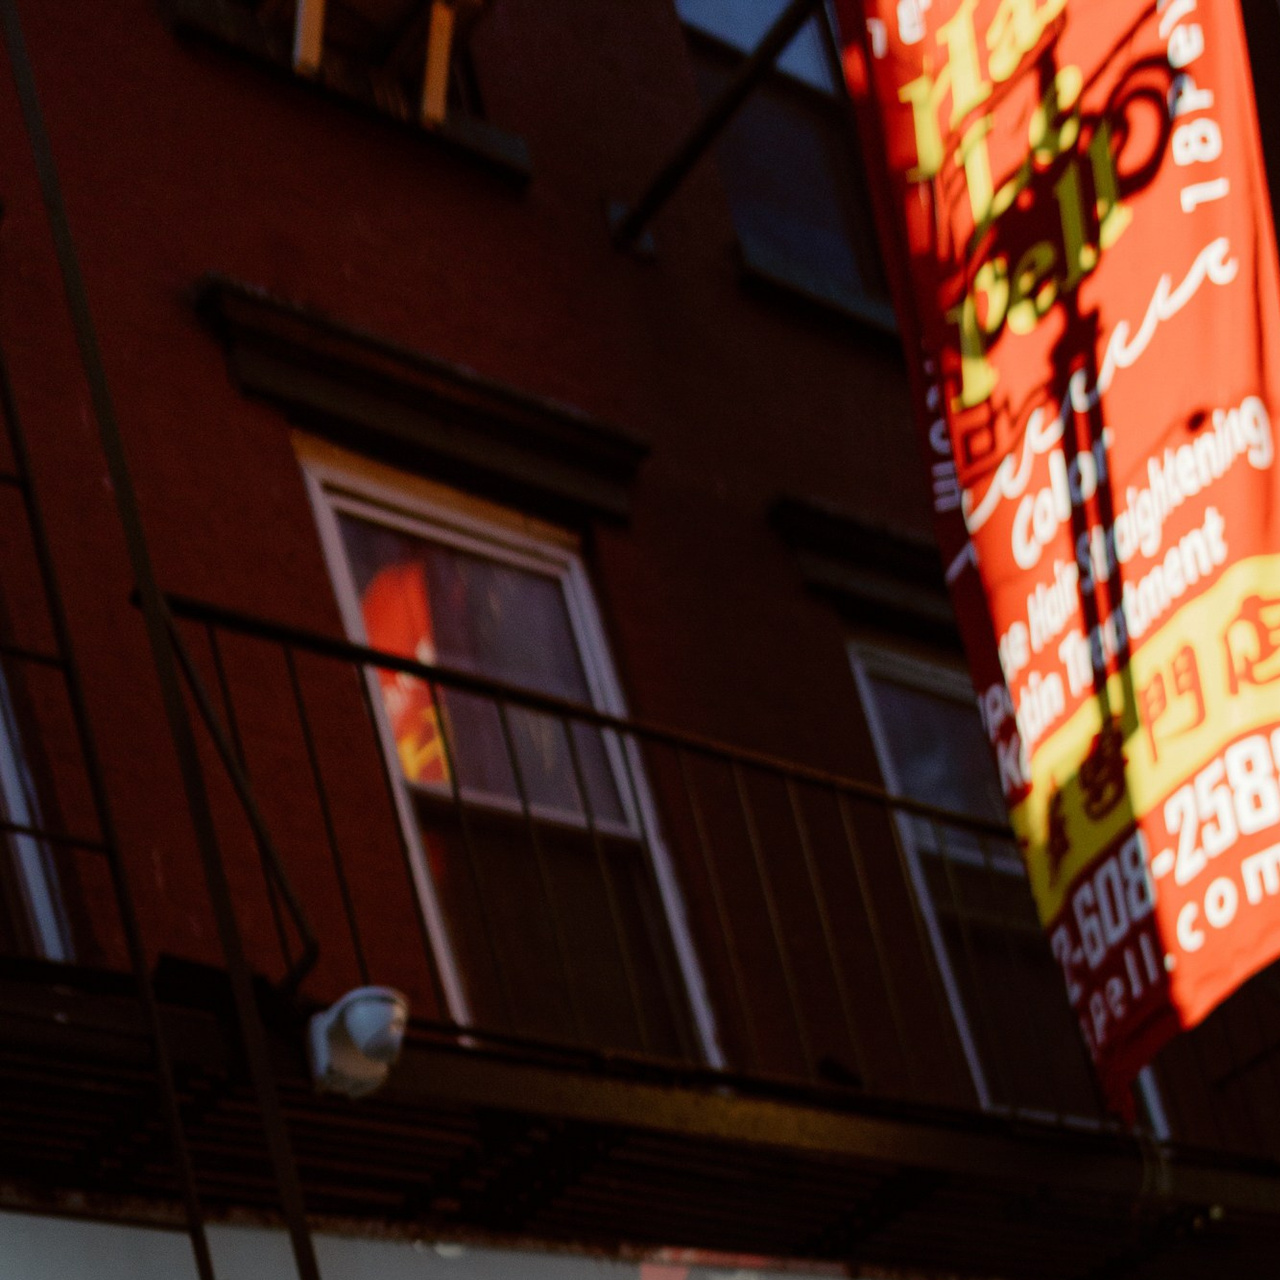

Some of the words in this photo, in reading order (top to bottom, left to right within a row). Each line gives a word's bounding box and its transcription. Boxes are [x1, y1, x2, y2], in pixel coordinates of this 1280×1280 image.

[1157, 0, 1231, 214] 18Pel
[1011, 426, 1115, 571] Color
[1075, 395, 1275, 597] Straightening
[1058, 506, 1228, 698] Treatment
